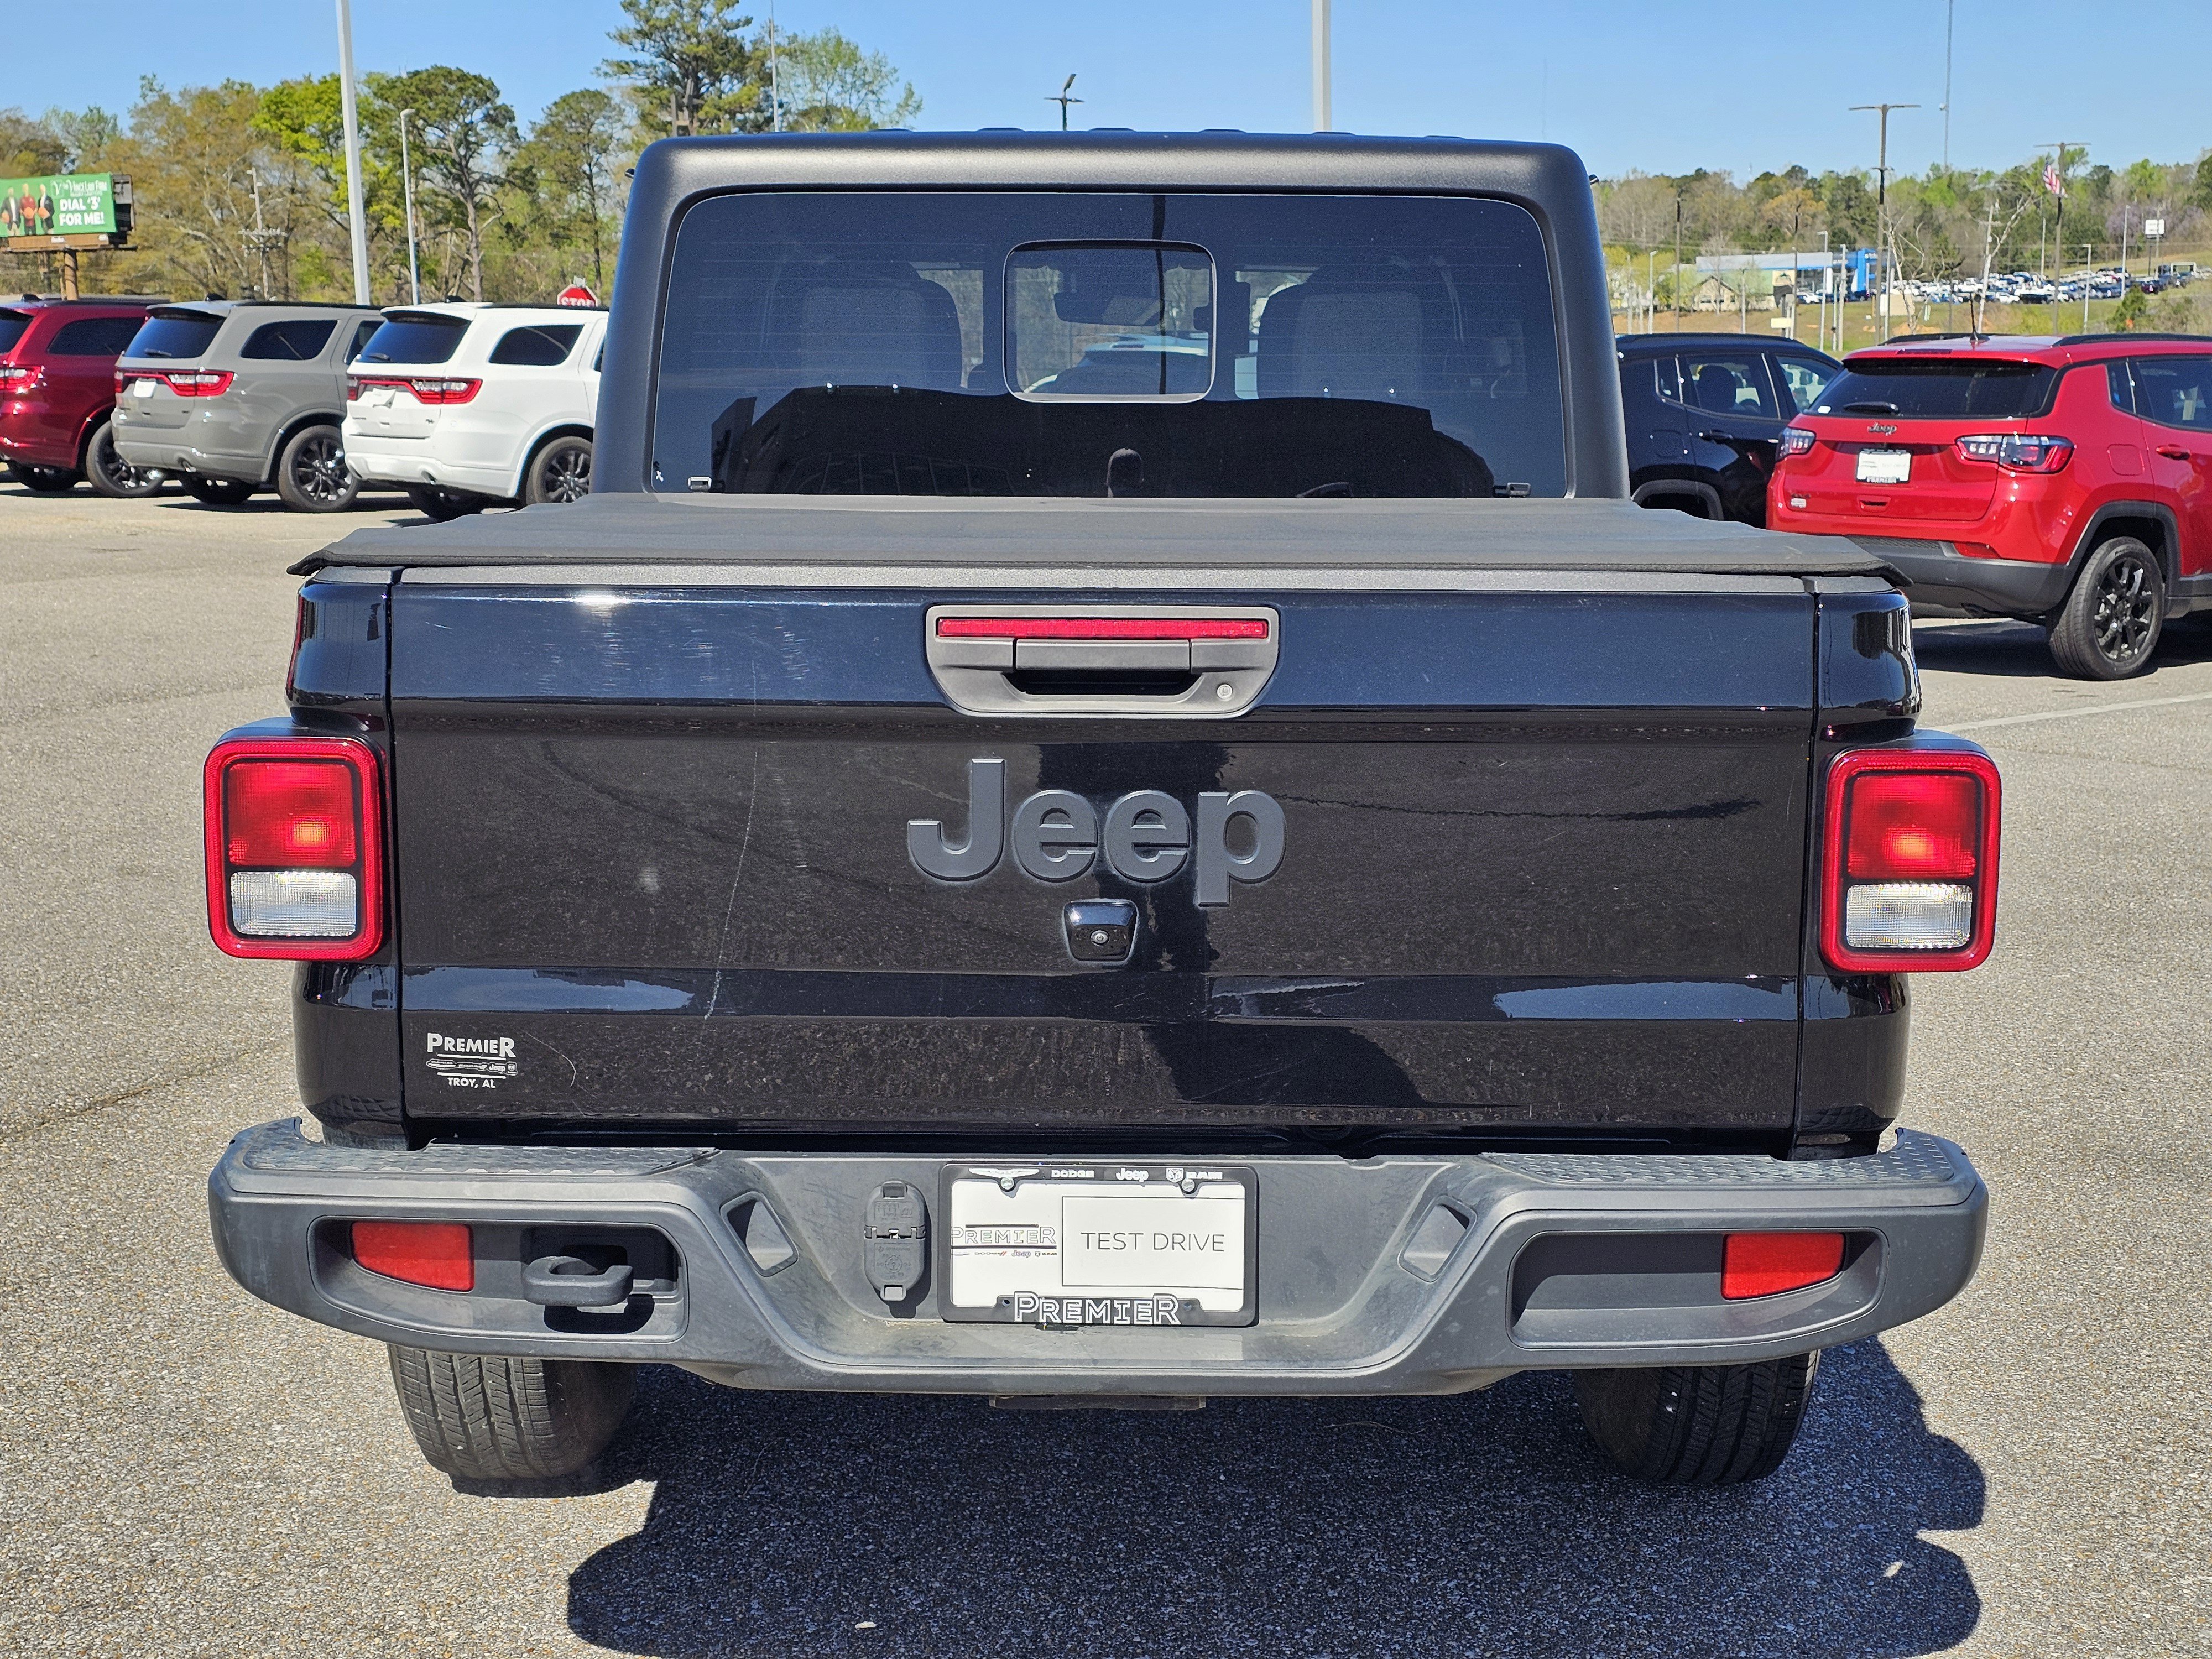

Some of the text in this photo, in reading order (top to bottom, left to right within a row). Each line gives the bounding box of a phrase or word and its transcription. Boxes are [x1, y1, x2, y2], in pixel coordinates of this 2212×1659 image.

[60, 198, 86, 211] DIAL
[59, 211, 105, 226] FOR ME!
[561, 296, 595, 307] STOP
[1867, 421, 1897, 436] Jeep
[907, 758, 1287, 908] Jeep
[427, 1032, 516, 1058] PREMIER
[447, 1077, 496, 1089] TROY, AL
[1051, 1169, 1095, 1178] DODGE
[1115, 1167, 1149, 1182] Jeep
[1186, 1171, 1223, 1180] RAM
[951, 1226, 1057, 1244] PREMIER
[1080, 1232, 1225, 1252] TEST DRIVE
[1011, 1250, 1031, 1258] Jeep
[1014, 1291, 1181, 1325] PREMIER
